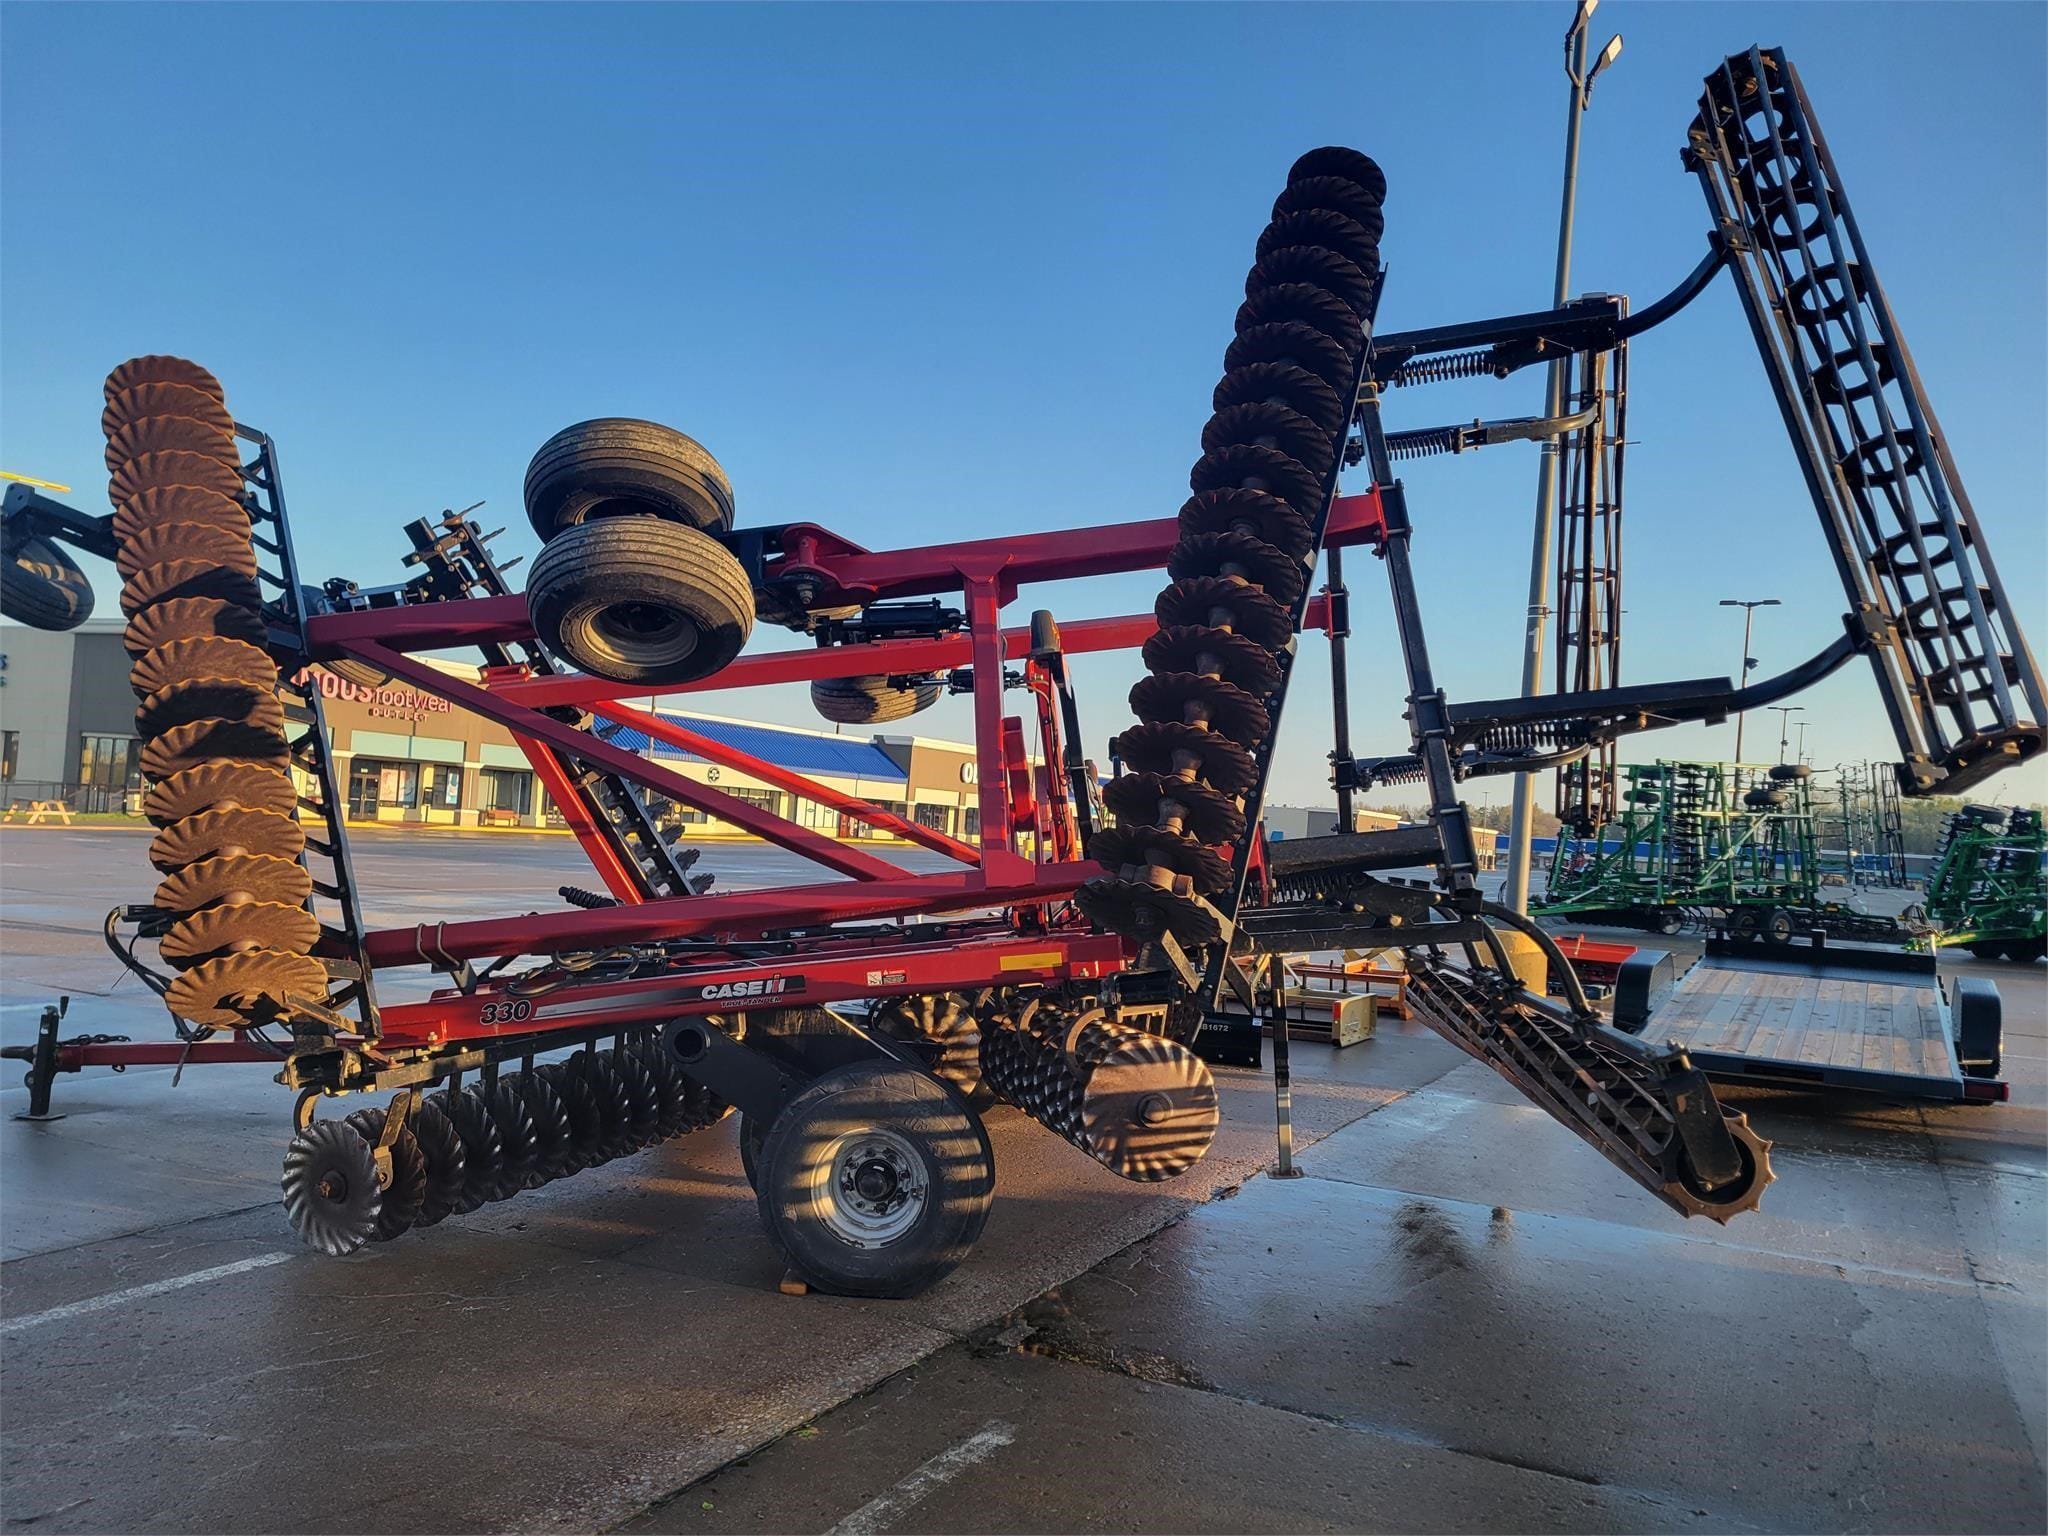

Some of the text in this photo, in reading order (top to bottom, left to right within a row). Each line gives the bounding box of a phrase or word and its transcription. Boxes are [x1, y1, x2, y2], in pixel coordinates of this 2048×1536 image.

[372, 707, 429, 722] OUTLET
[701, 980, 764, 1000] CASE
[480, 1000, 531, 1025] 330
